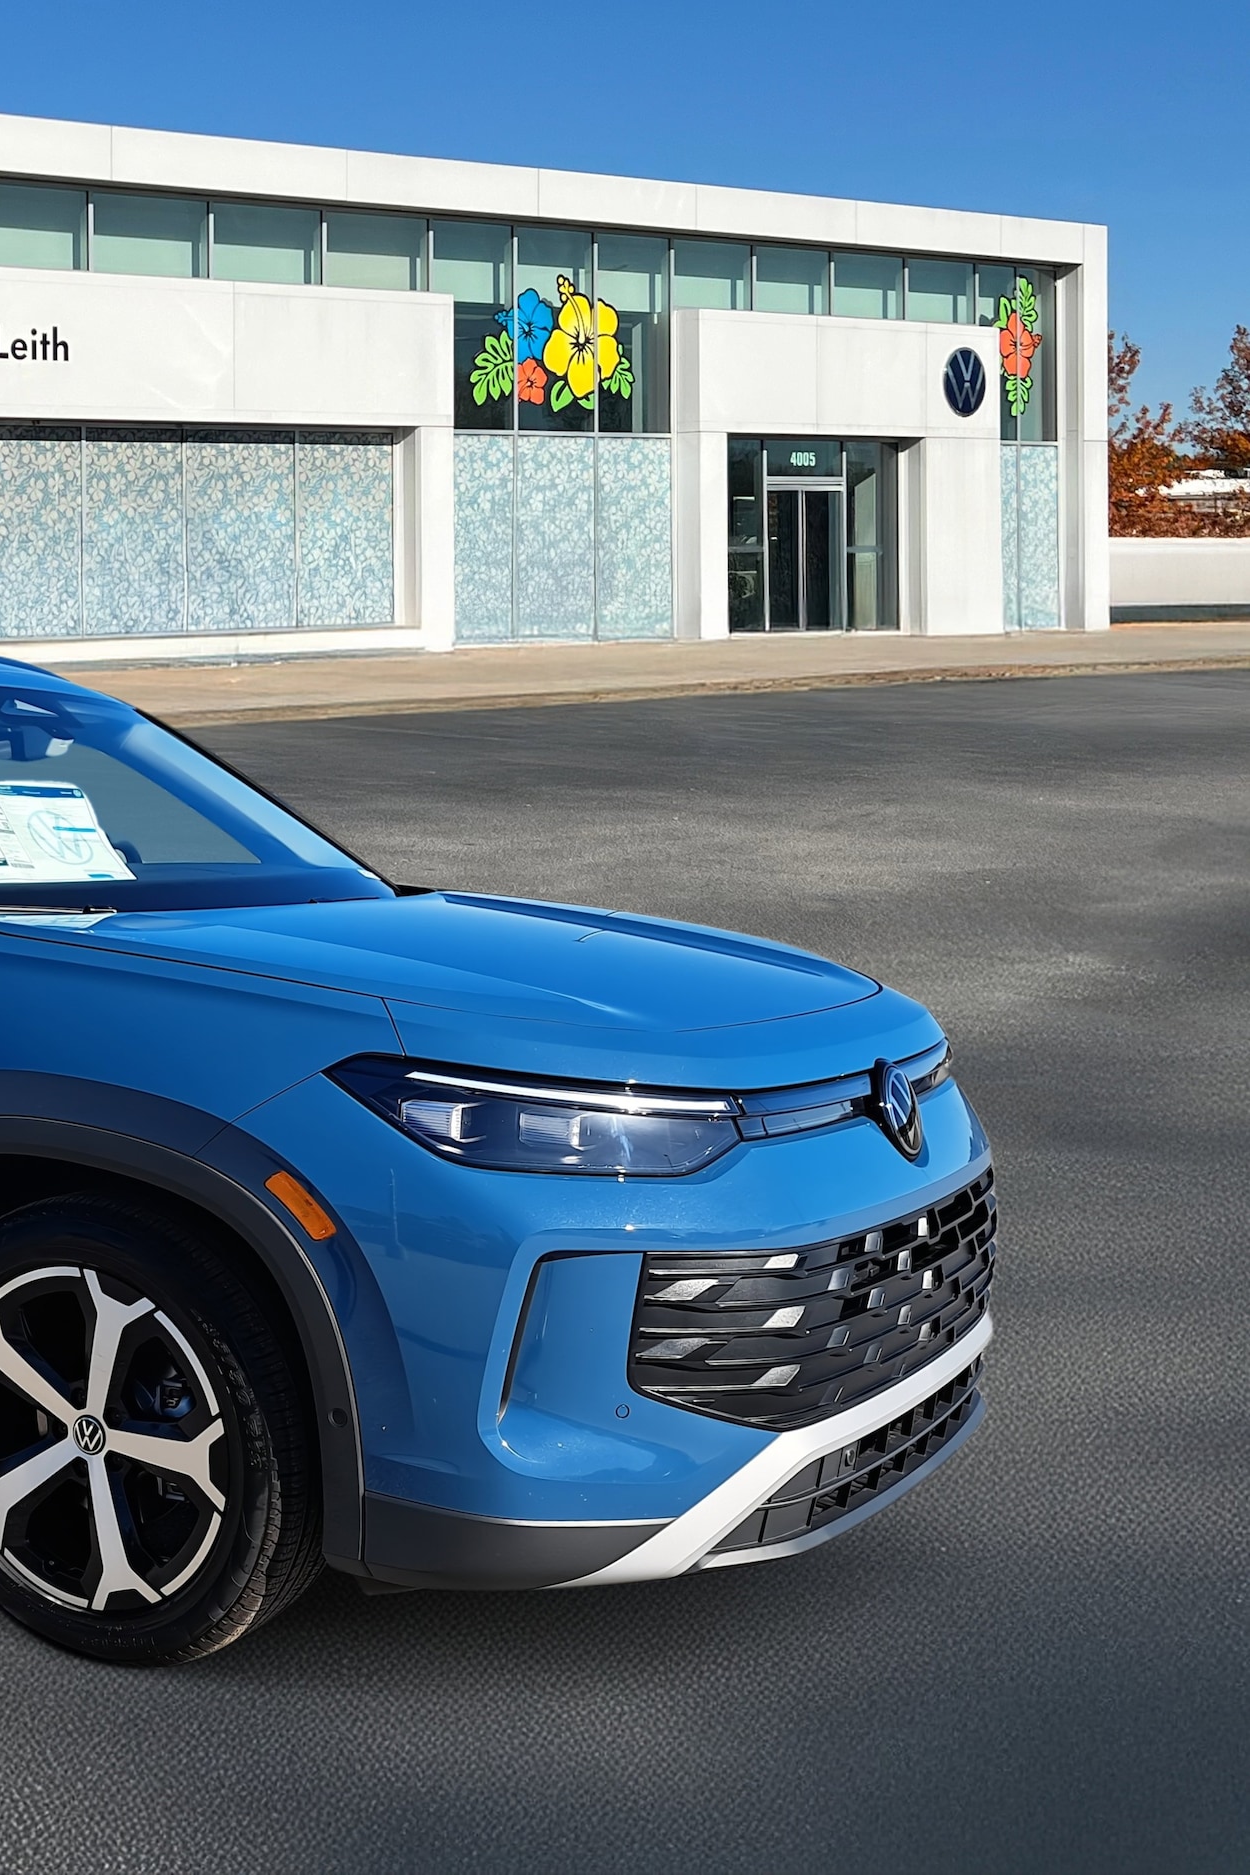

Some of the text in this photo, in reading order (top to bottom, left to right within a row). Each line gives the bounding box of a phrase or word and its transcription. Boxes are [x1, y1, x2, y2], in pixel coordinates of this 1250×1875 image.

[943, 347, 986, 417] VW
[790, 452, 816, 466] 4005
[73, 1416, 104, 1454] VW
